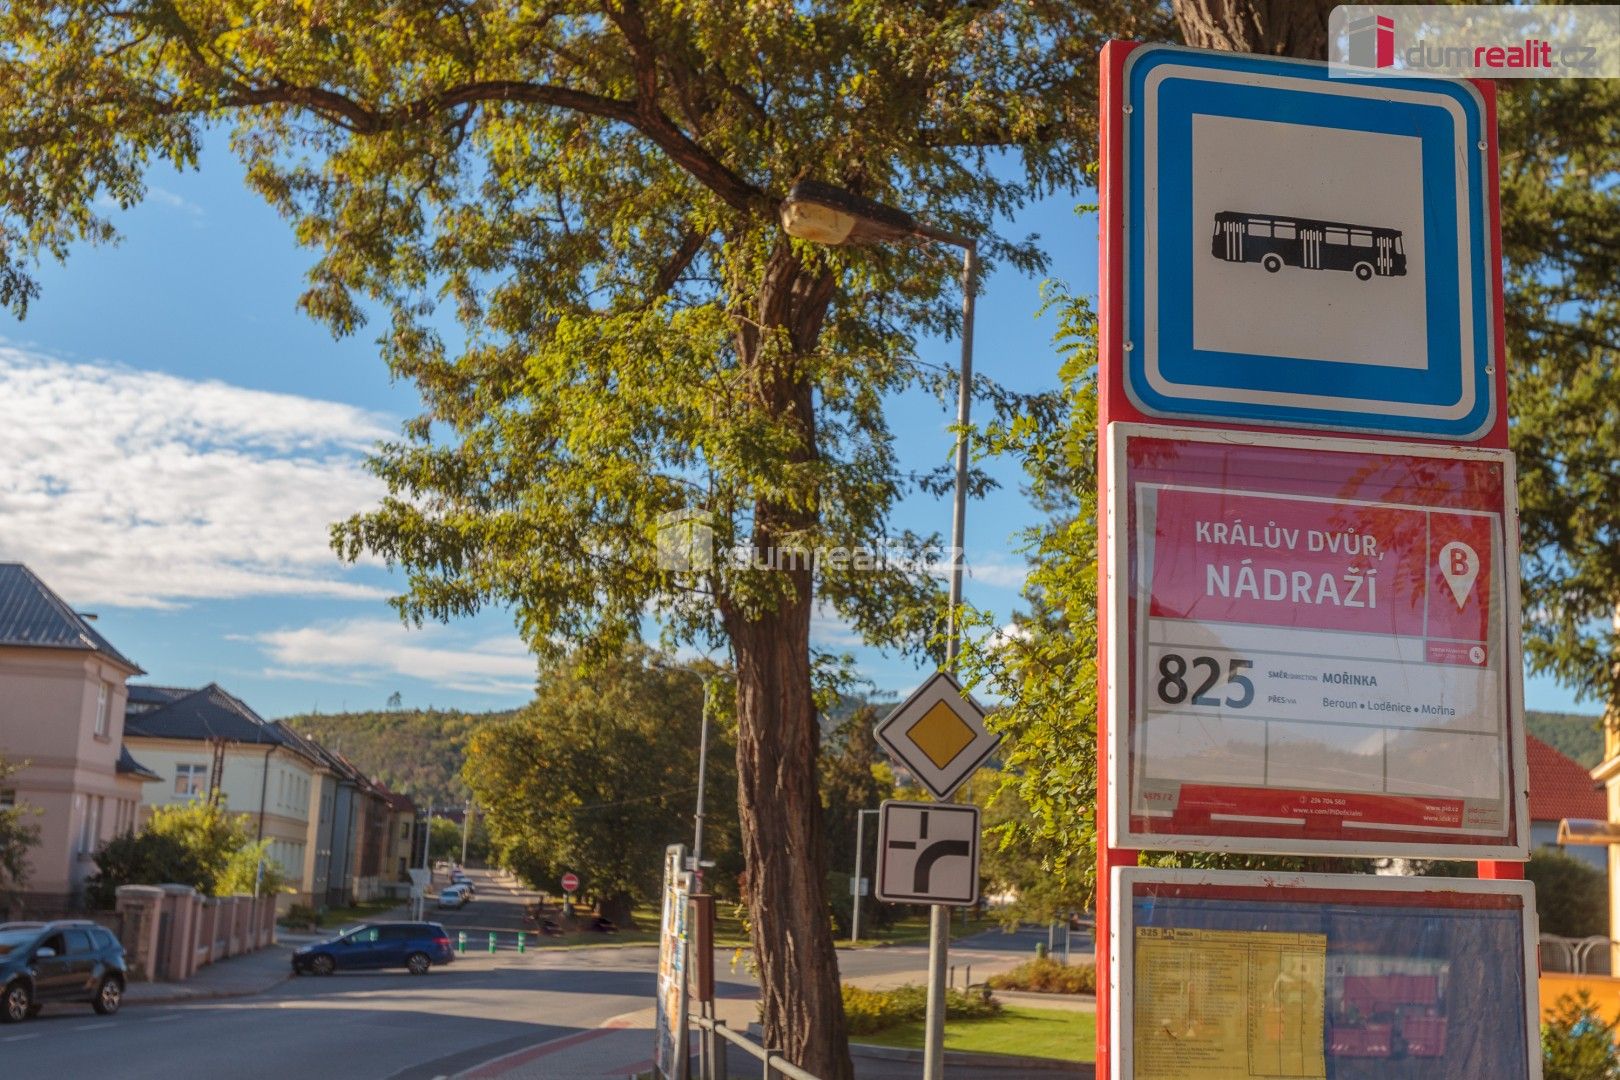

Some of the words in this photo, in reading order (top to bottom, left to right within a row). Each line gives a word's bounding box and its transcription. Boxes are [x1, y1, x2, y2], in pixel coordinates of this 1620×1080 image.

[1196, 519, 1299, 550] KRÁLŮV
[1307, 527, 1385, 561] DVŮR,
[1450, 548, 1469, 576] B
[1206, 558, 1377, 609] NÁDRAŽÍ
[1157, 653, 1255, 709] 825
[1322, 671, 1378, 687] MOŘINKA
[1322, 697, 1358, 710] Beroun
[1367, 700, 1412, 713] Loděnice
[1421, 704, 1456, 716] Mořina
